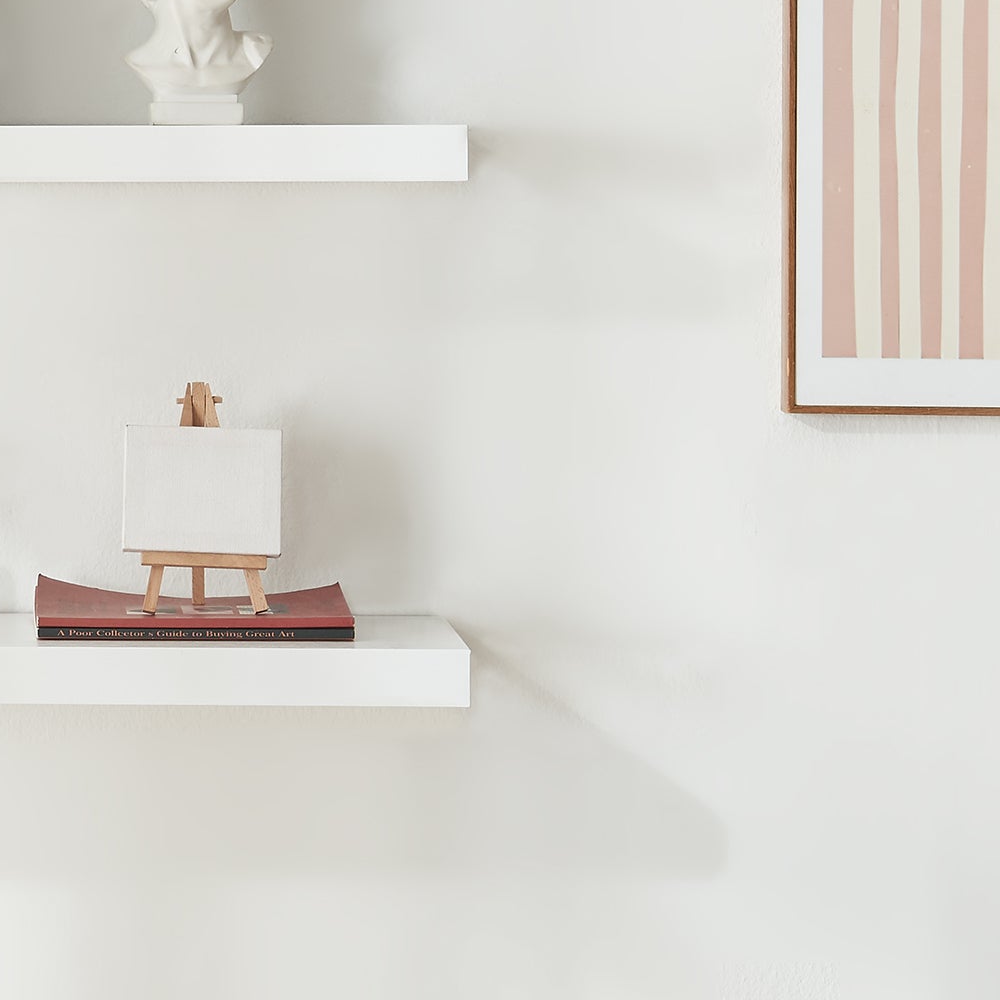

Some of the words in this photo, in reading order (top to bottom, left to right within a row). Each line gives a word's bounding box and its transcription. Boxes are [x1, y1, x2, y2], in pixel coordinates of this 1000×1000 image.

[57, 629, 65, 637] A
[69, 629, 93, 637] Poor
[156, 629, 189, 637] Guide
[206, 630, 243, 639] Buying
